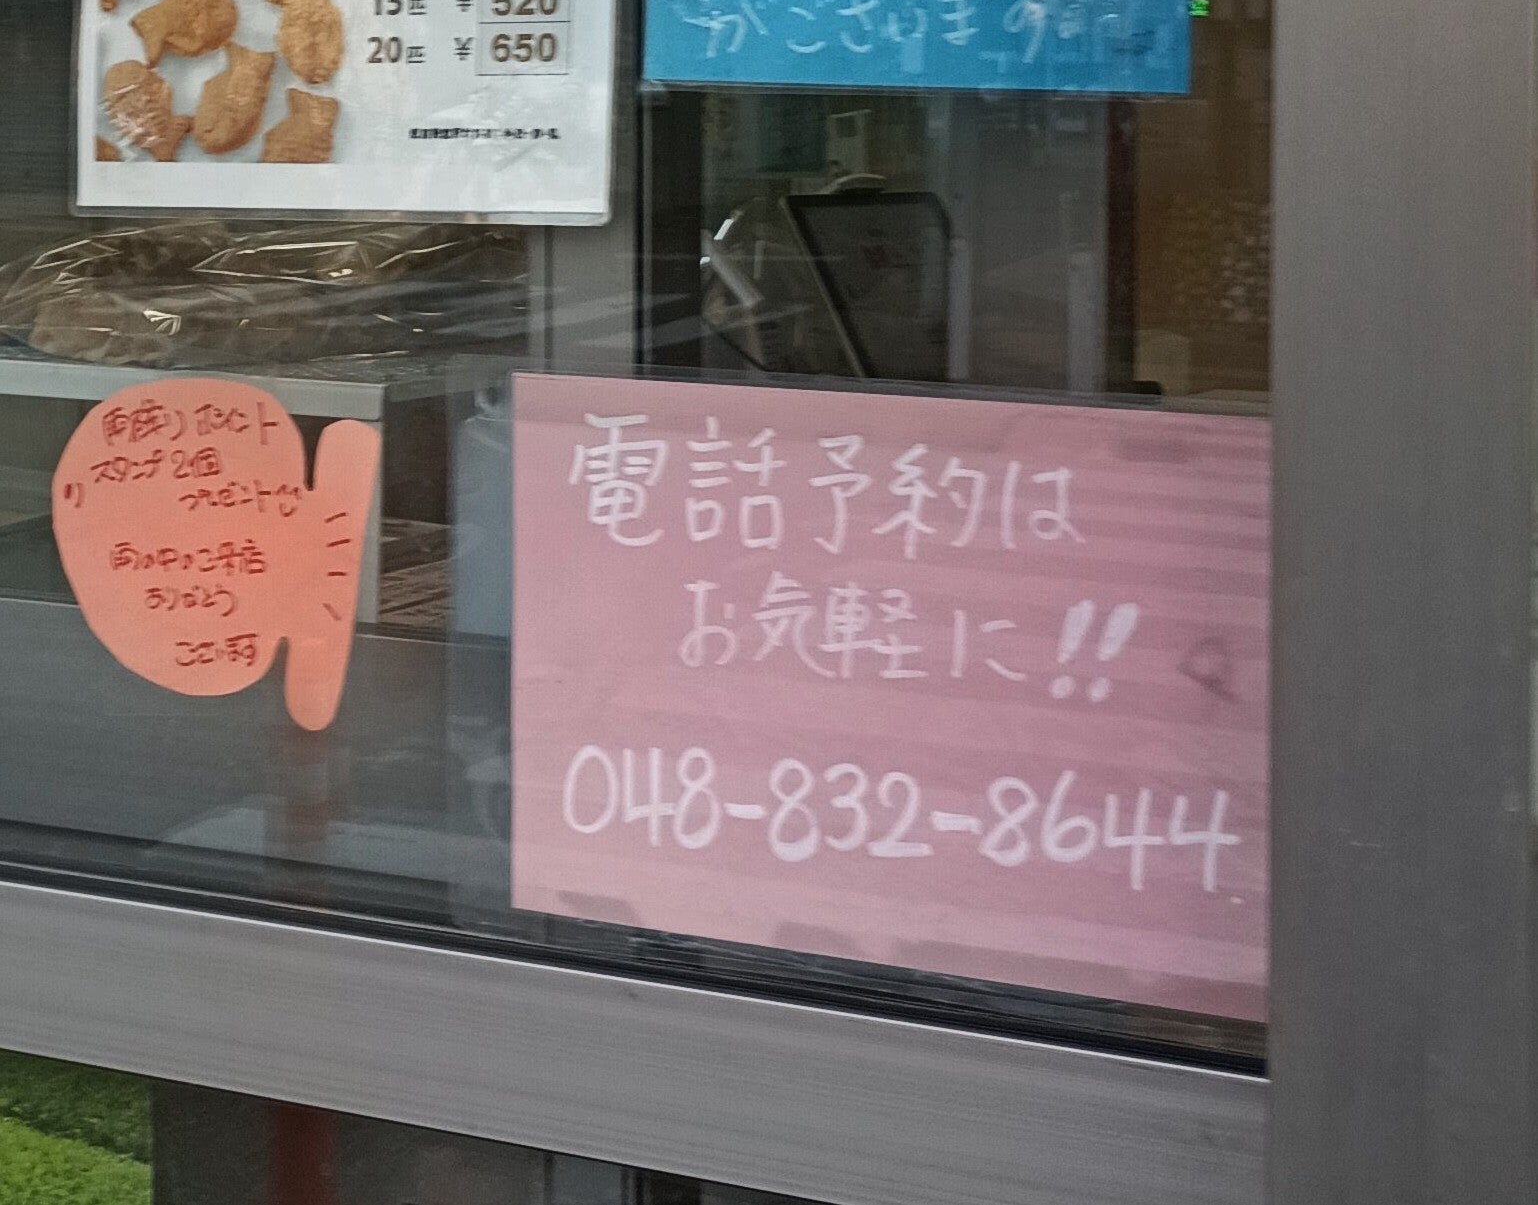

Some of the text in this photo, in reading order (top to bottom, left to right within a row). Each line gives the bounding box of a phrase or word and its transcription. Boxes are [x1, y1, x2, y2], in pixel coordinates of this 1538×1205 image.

[491, 32, 558, 63] 650
[567, 412, 1088, 560] 電話予約は
[562, 743, 1242, 894] 048-832-8644
